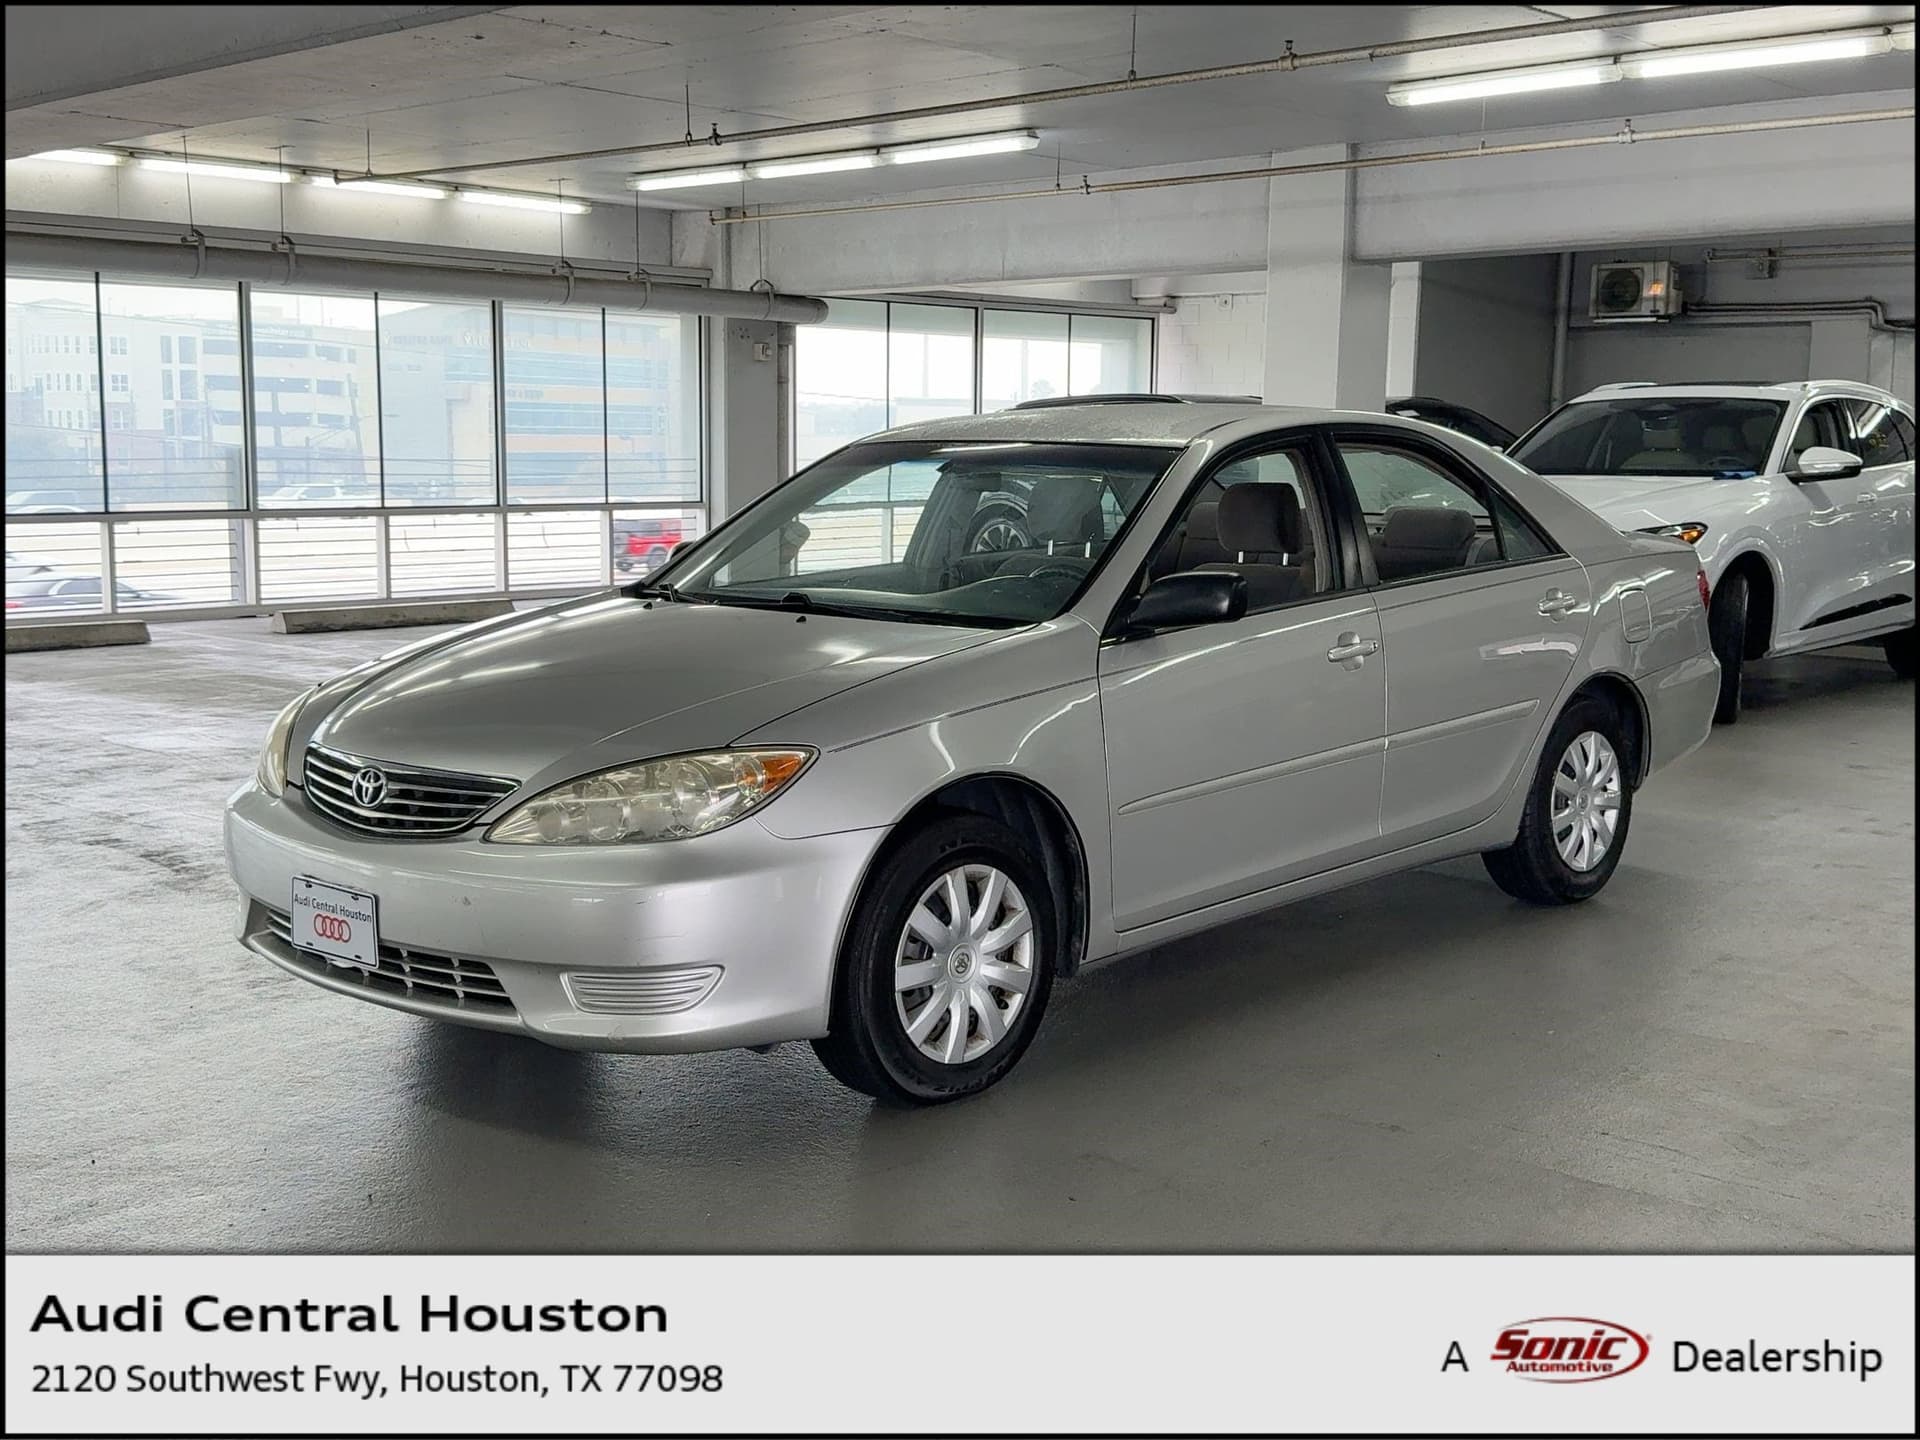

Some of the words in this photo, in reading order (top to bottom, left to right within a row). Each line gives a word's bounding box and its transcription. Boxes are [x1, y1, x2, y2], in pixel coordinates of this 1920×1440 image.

[294, 893, 310, 907] Audi
[312, 898, 338, 914] Central
[340, 905, 372, 923] Houston
